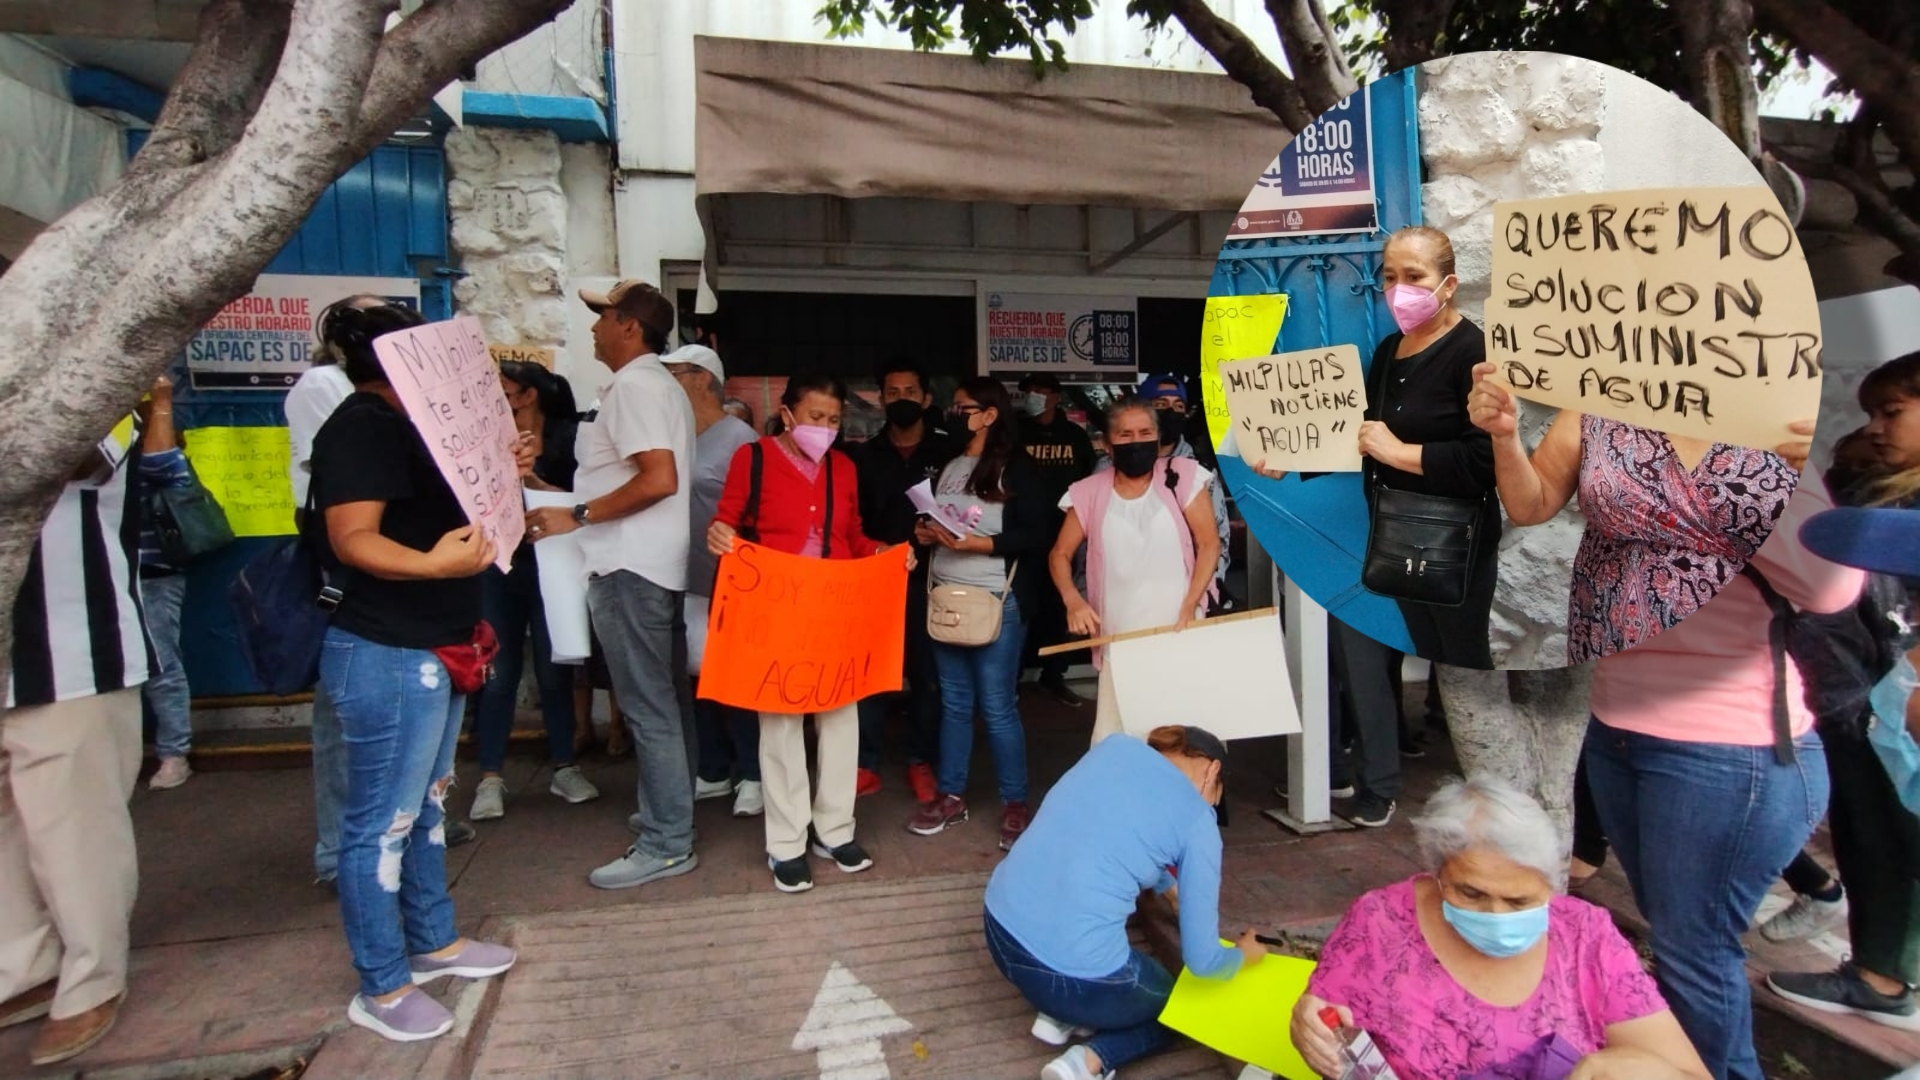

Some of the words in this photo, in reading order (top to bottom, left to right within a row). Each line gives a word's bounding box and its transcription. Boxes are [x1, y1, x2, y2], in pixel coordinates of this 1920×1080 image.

[1296, 120, 1352, 153] 18:00
[1297, 152, 1354, 179] HORAS
[1506, 199, 1793, 260] QUEREMO
[221, 297, 275, 315] UERDA
[279, 298, 310, 315] QUE
[203, 315, 252, 330] ESTRO
[255, 316, 312, 331] HORARIO
[989, 311, 1043, 326] RECUERDA
[1045, 311, 1066, 326] QUE
[1100, 314, 1129, 329] 08:00
[1205, 305, 1254, 330] apac
[989, 326, 1028, 338] NUESTRO
[1030, 327, 1067, 338] HORARIO
[1100, 332, 1129, 347] 18:00
[191, 341, 255, 361] SAPAC
[261, 342, 284, 362] ES
[290, 342, 313, 362] DE
[990, 346, 1030, 363] SAPAC
[1033, 346, 1050, 363] ES
[1052, 346, 1067, 363] DE
[1101, 347, 1130, 359] HORAS
[1228, 353, 1345, 393] MILPILLAS
[1502, 361, 1553, 391] DE
[1579, 368, 1714, 424] AGUA
[755, 651, 871, 710] AGUA!
